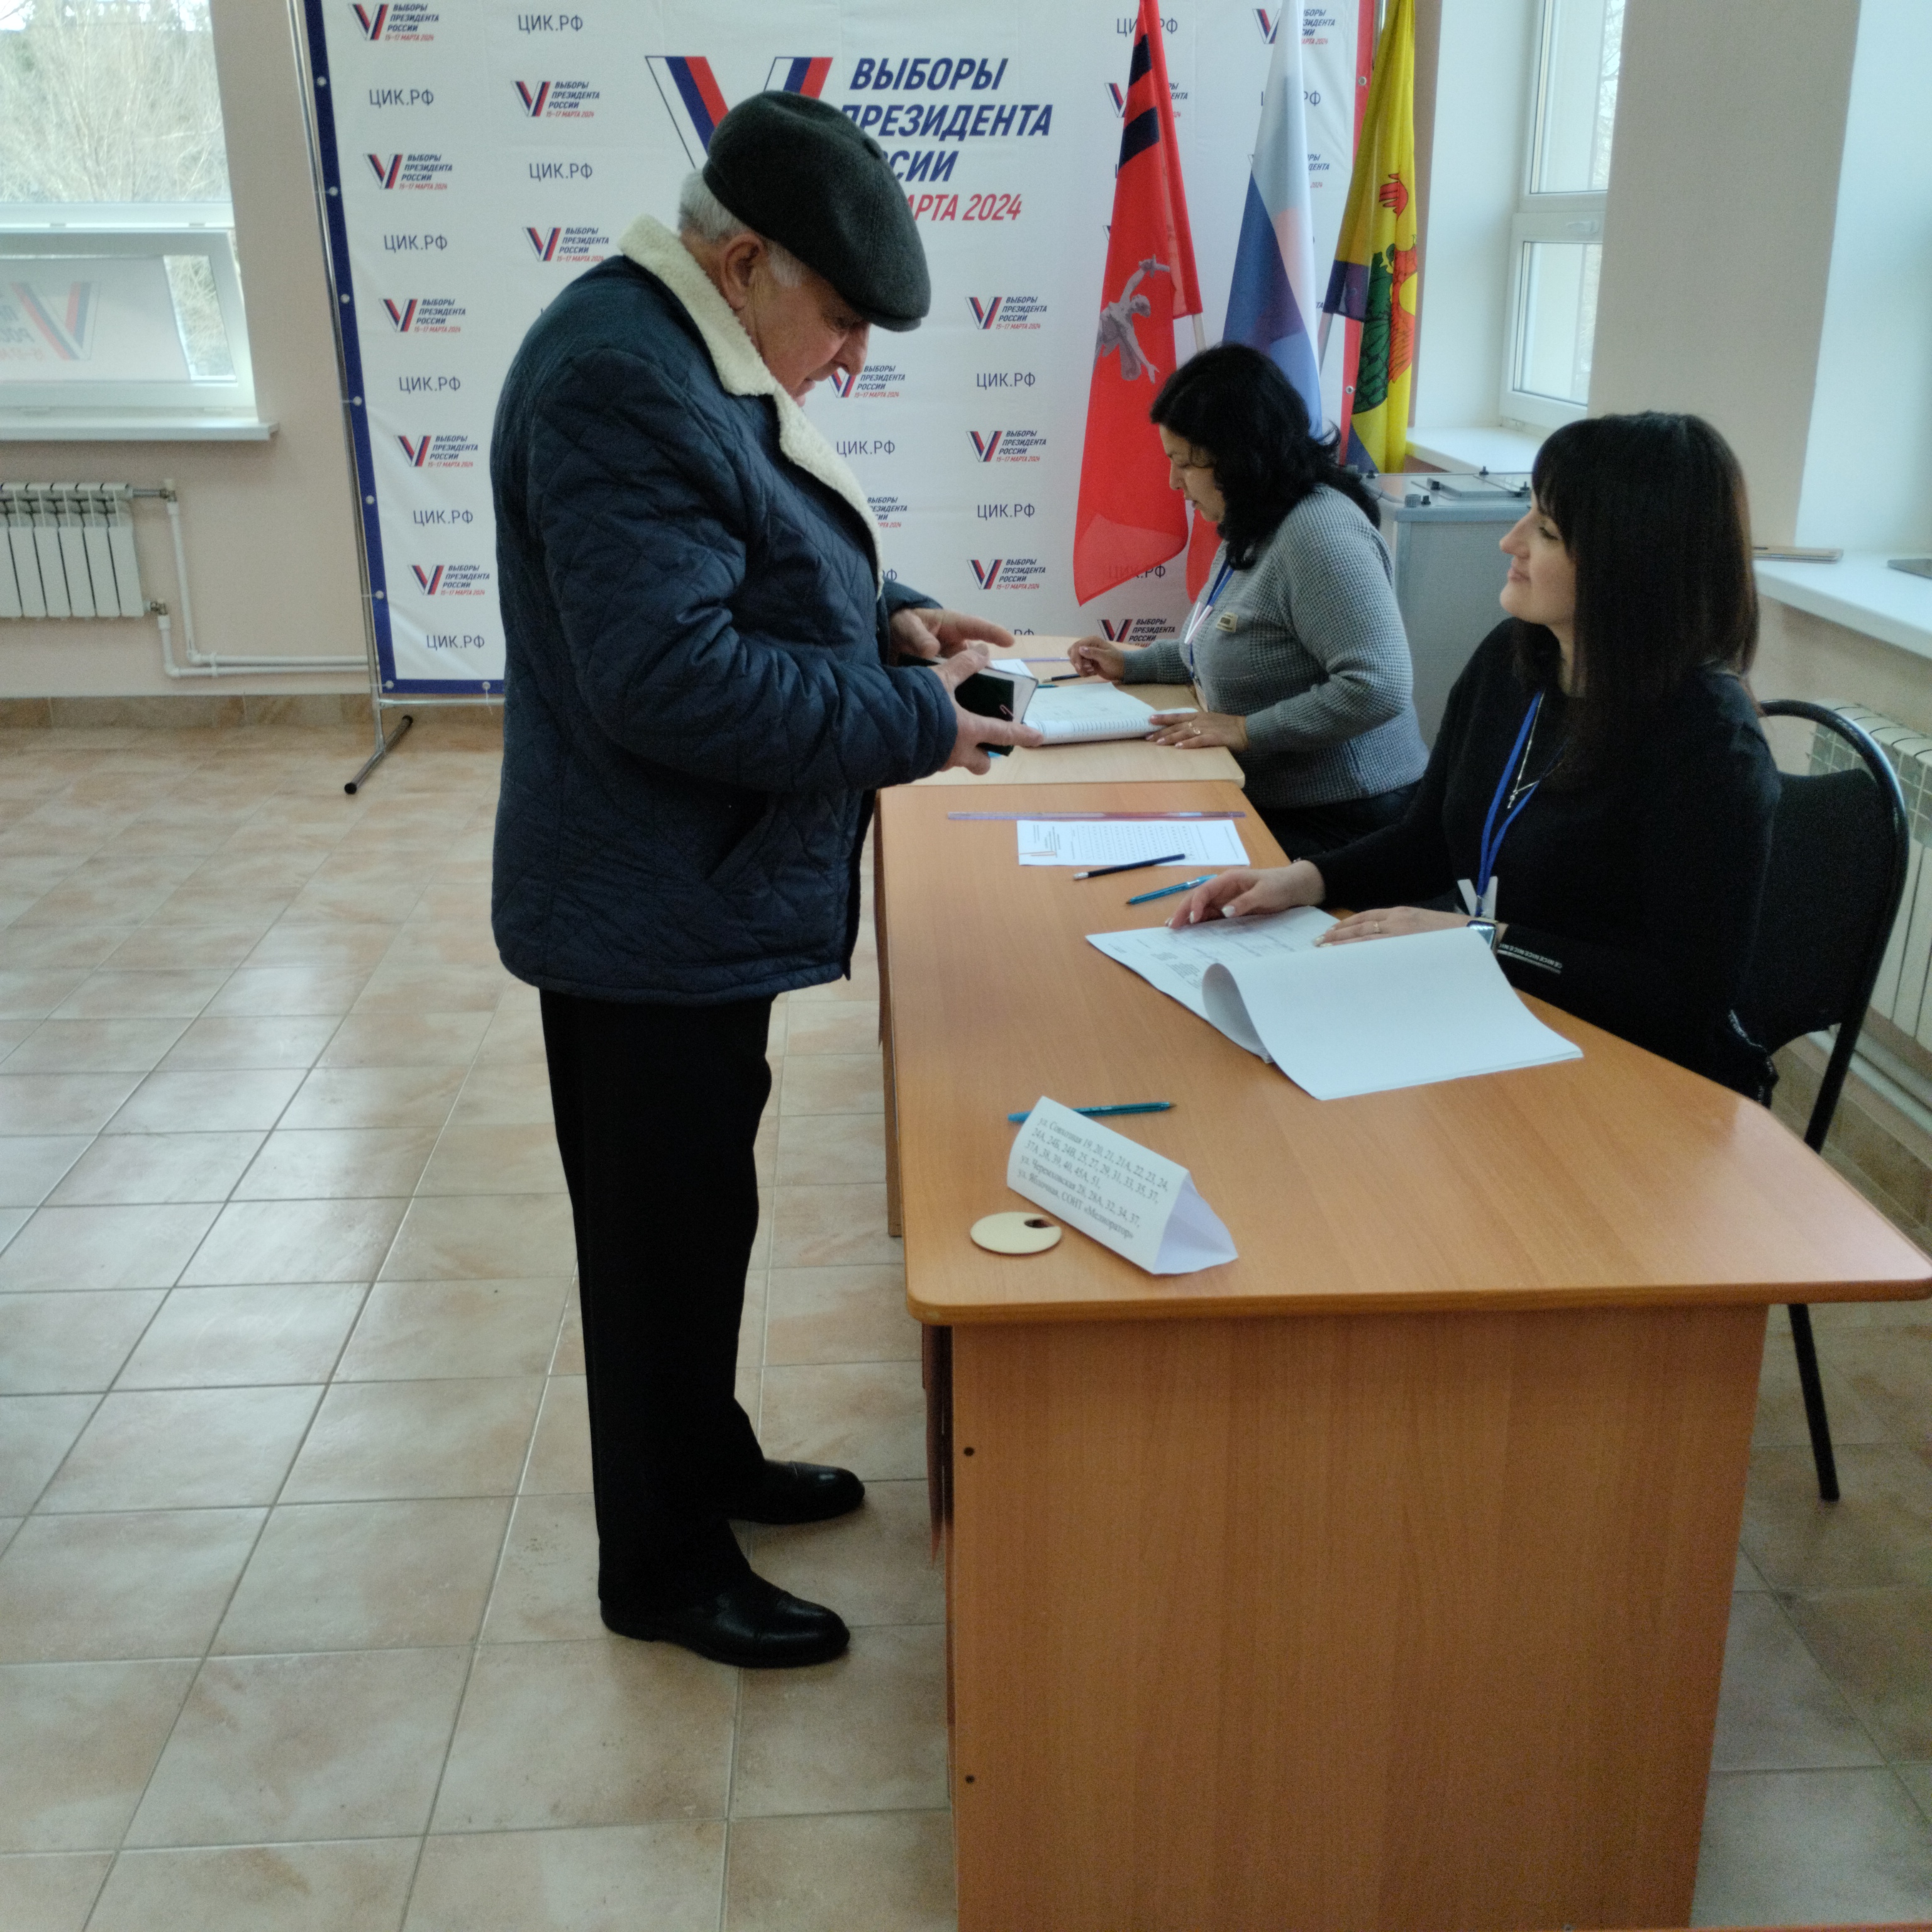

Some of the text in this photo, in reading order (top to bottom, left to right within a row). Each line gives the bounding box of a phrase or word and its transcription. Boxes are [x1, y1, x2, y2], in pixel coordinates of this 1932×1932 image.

[390, 14, 439, 23] ПРЕЗИДЕНТА
[518, 14, 583, 33] ЦИК.РФ
[849, 58, 1009, 90] ВЫБОРЫ
[369, 89, 434, 108] ЦИК.РФ
[552, 91, 599, 99] ПРЕЗИДЕНТА
[404, 164, 452, 172] ПРЕЗИДЕНТА
[529, 163, 592, 181] ЦИК.РФ
[905, 194, 1022, 221] АРТА 2024
[384, 235, 447, 252] ЦИК.РФ
[419, 308, 465, 316] ПРЕЗИДЕНТА
[399, 377, 460, 394] ЦИК.РФ
[977, 372, 1035, 390] ЦИК.РФ
[836, 440, 895, 457] ЦИК.РФ
[413, 510, 473, 526] ЦИК.РФ
[977, 504, 1035, 520] ЦИК.РФ
[426, 635, 485, 649] ЦИК.РФ
